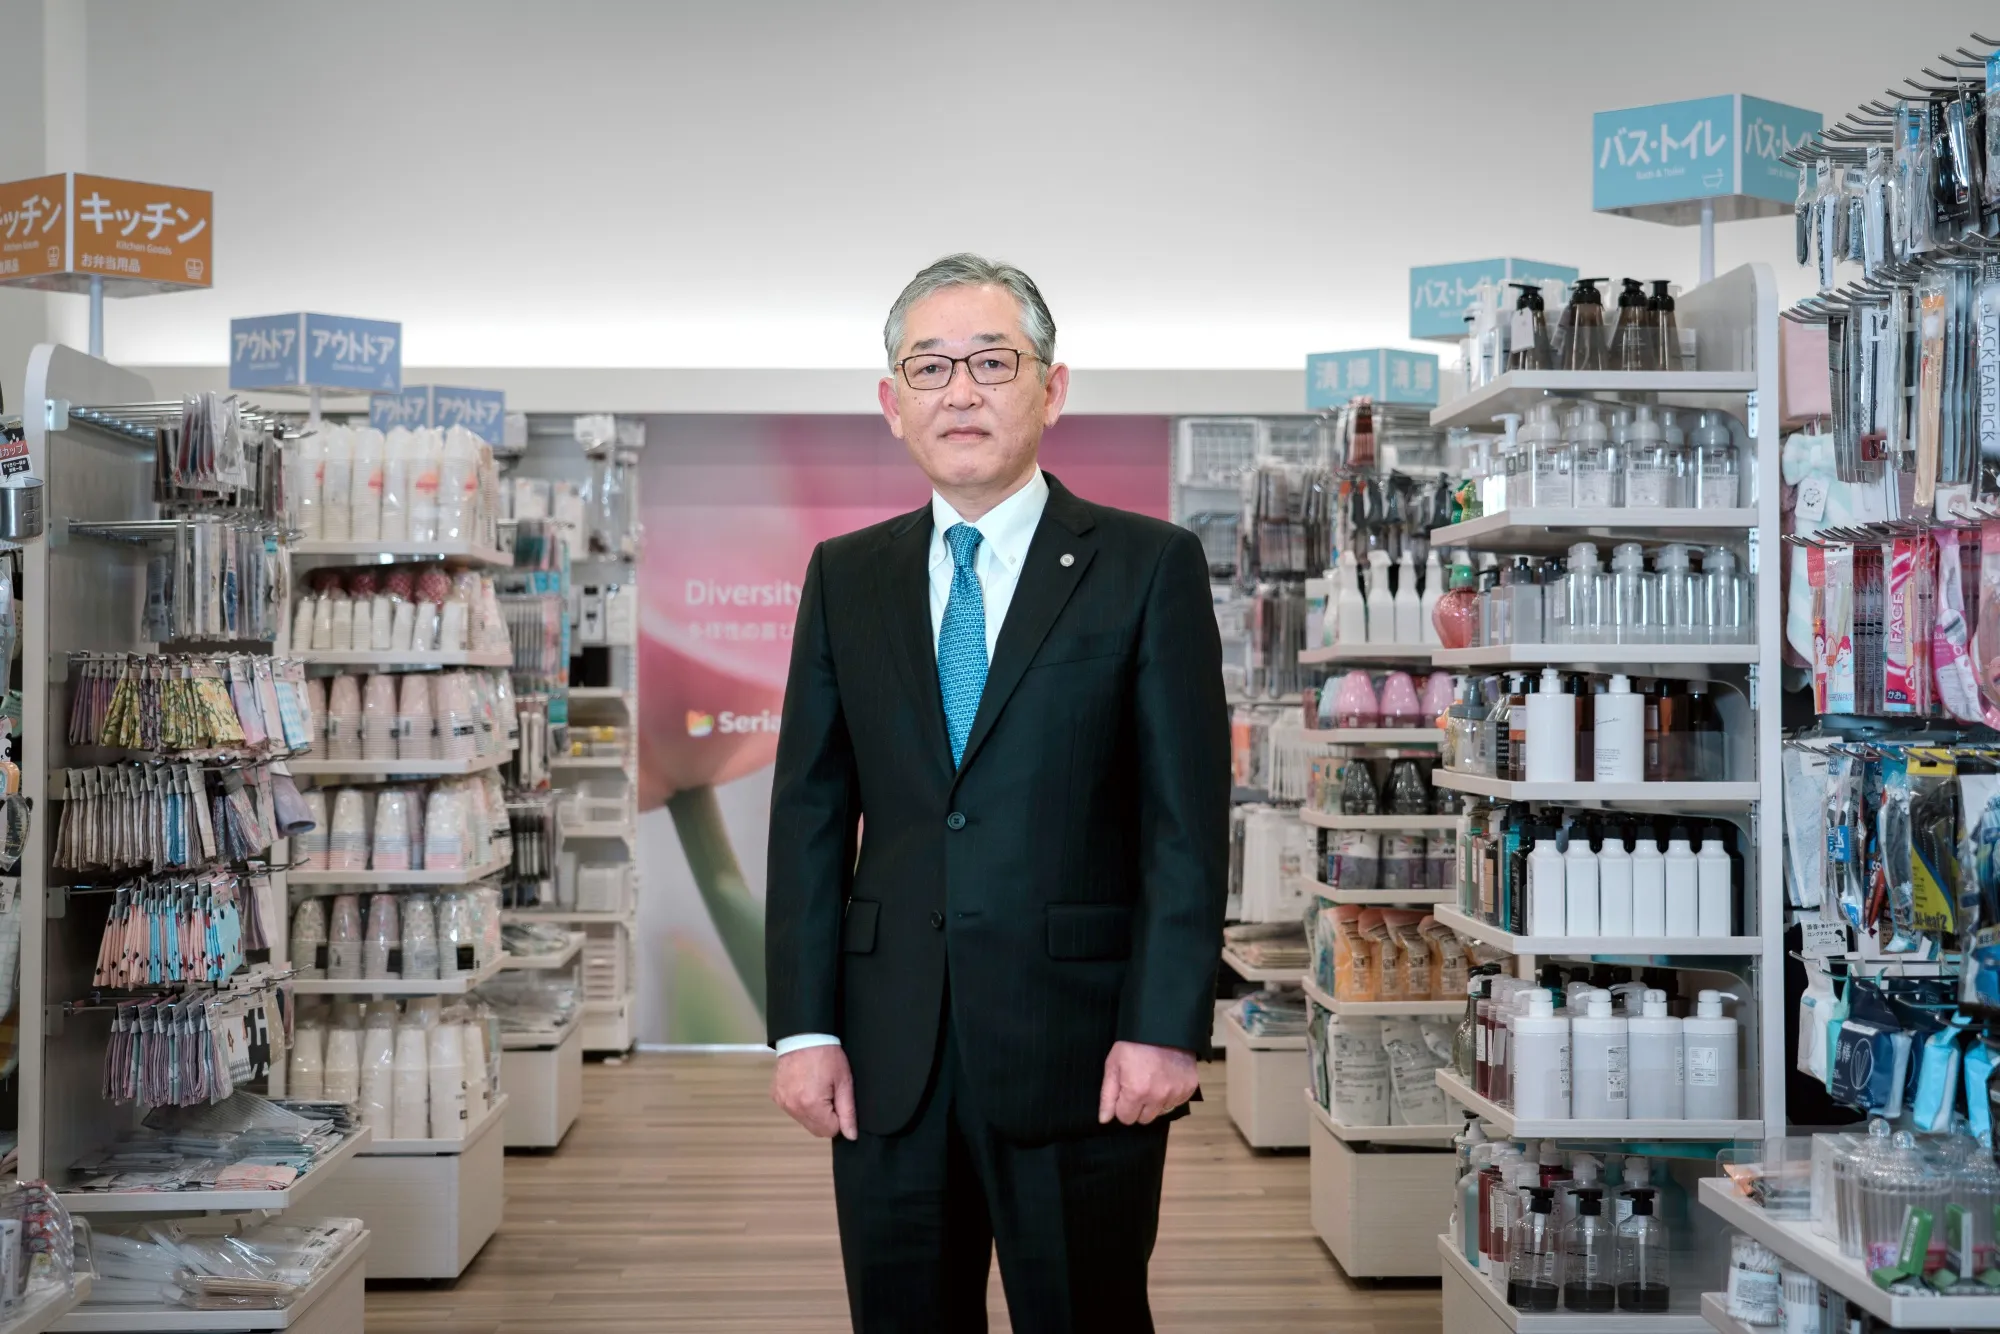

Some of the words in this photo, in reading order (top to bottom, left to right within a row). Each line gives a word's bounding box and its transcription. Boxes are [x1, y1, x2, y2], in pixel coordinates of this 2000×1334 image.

[1600, 120, 1726, 169] バス・トイレ
[0, 194, 62, 239] ッチン
[80, 192, 206, 244] キッチン
[81, 252, 140, 273] お弁当用品
[234, 328, 296, 362] アウトドア
[312, 328, 396, 364] アウトドア
[1982, 364, 1996, 398] EAR
[1982, 402, 1996, 441] PICK
[1890, 592, 1904, 644] FACE
